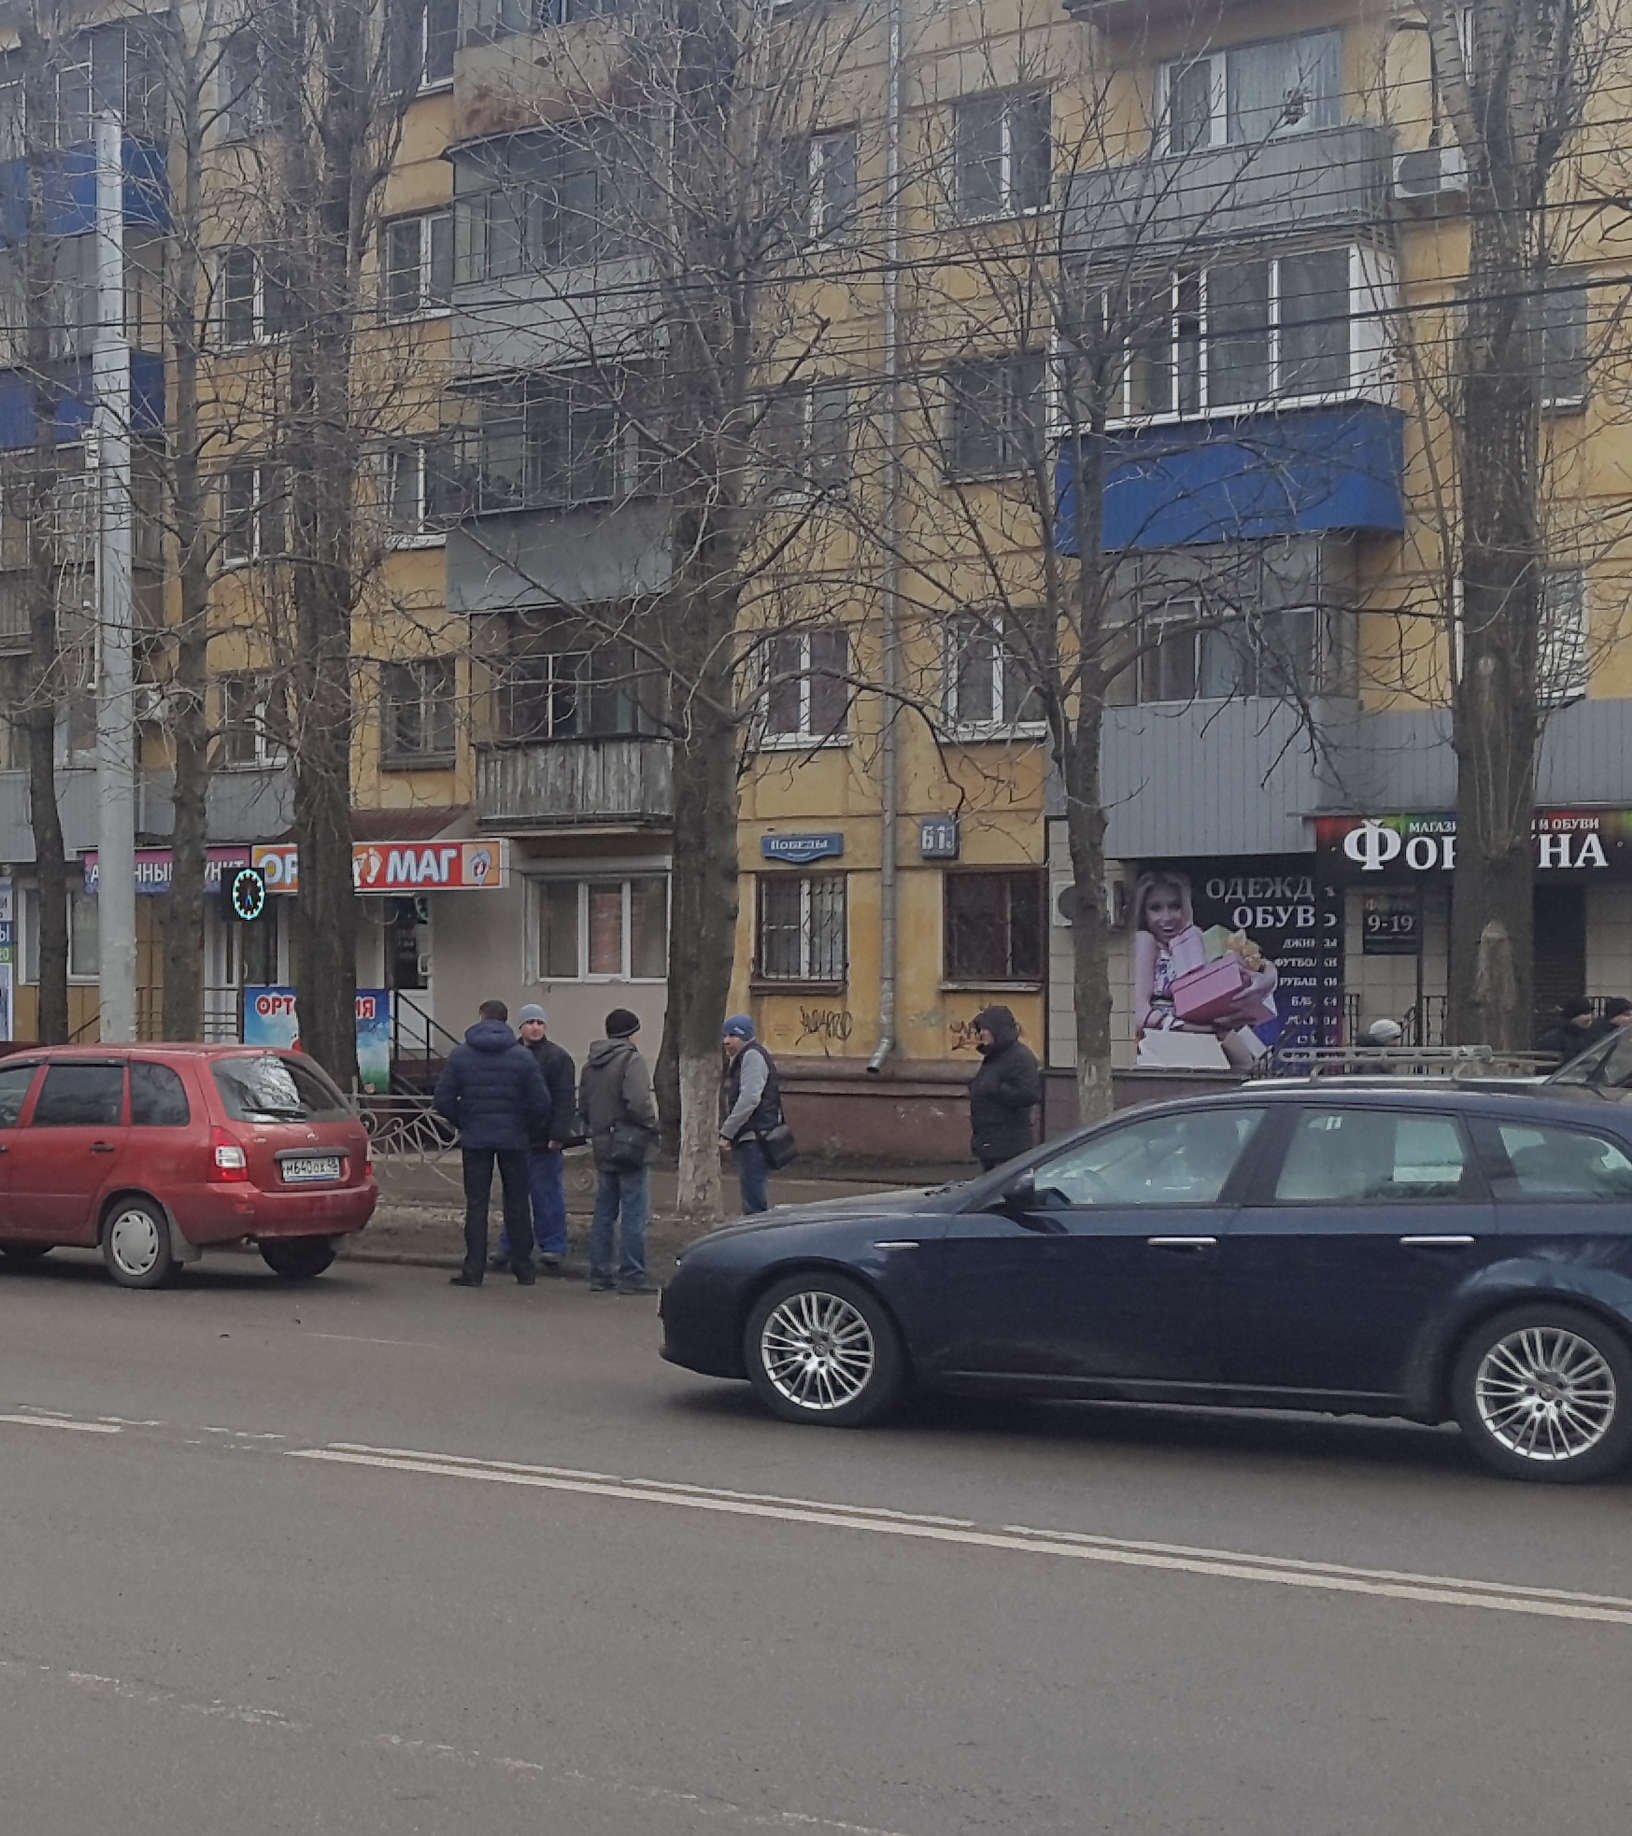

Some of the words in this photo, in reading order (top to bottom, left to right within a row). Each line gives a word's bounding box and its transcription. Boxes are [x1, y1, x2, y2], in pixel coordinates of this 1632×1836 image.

[1409, 819, 1456, 833] МАГАЗ
[1552, 818, 1599, 830] ОБУВИ
[1343, 818, 1609, 870] ФОНА
[386, 847, 457, 883] МАГ
[1275, 957, 1338, 968] ФУТБОИ
